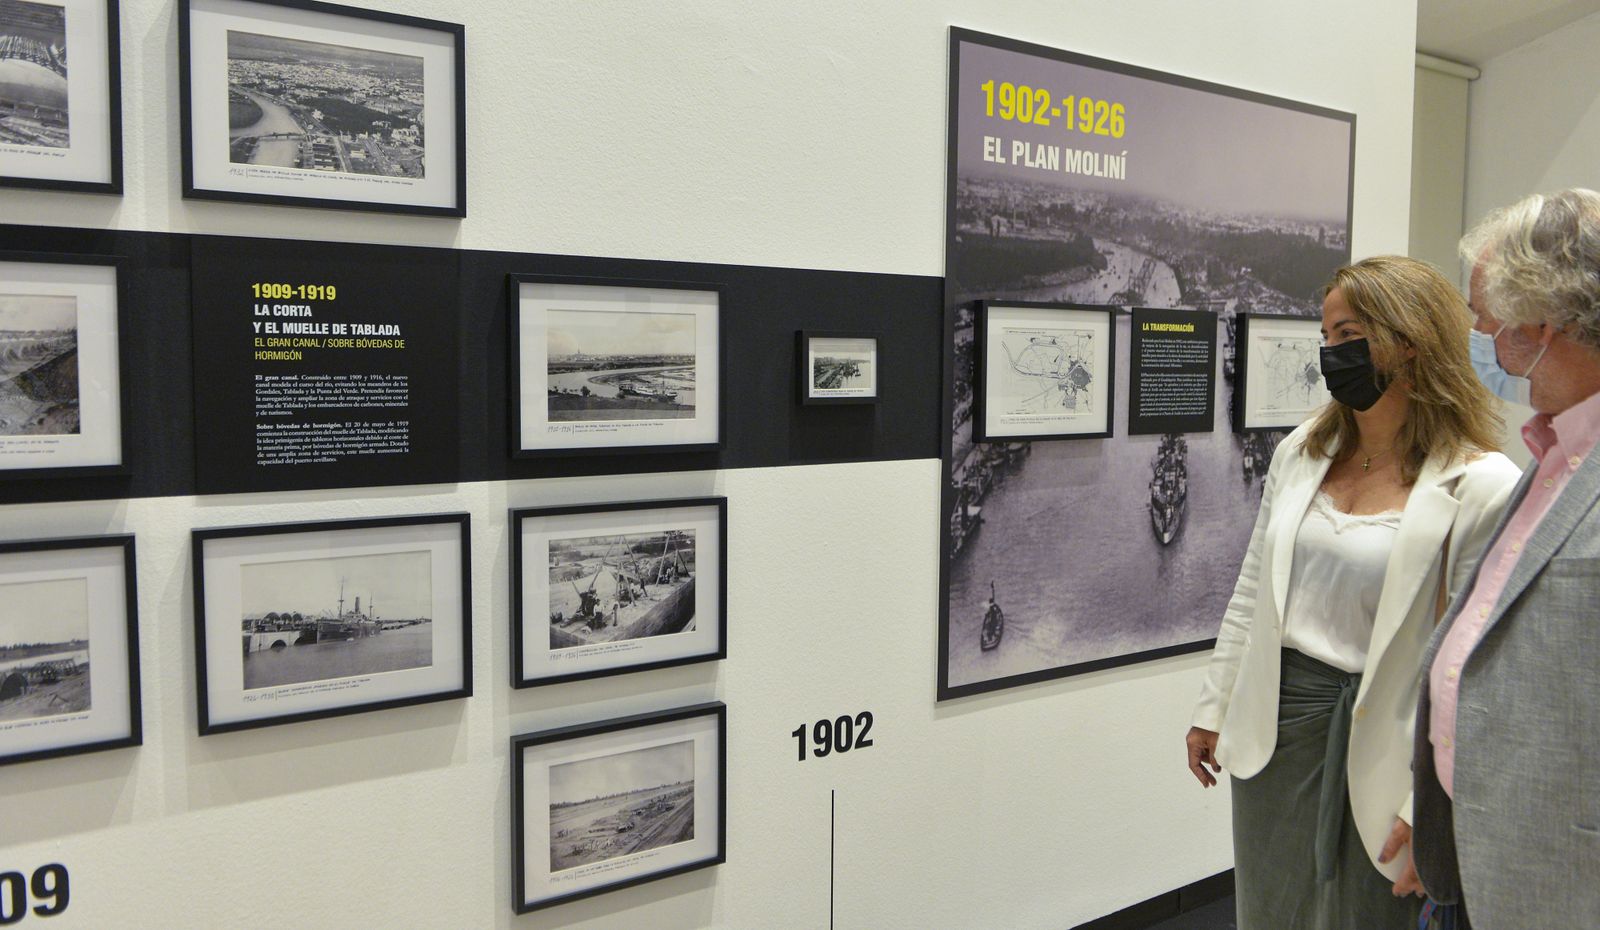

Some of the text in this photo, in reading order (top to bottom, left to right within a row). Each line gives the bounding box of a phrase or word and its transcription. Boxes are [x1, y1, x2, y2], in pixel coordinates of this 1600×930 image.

[981, 79, 1126, 139] 1902-1926
[983, 135, 1128, 181] EL PLAN MOLINÍ
[252, 283, 336, 301] 1909-1919
[254, 304, 312, 317] LA CORTA
[253, 322, 401, 336] Y EL MUELLE DE TABLADA
[1142, 322, 1195, 332] LA TRANSFORMACIÓN
[255, 338, 264, 348] EL
[267, 338, 290, 348] GRAN
[293, 338, 320, 348] CANAL
[328, 338, 354, 349] SOBRE
[356, 337, 392, 349] BÓVEDAS
[395, 339, 405, 349] DE
[255, 349, 302, 361] HORMIGÓN
[792, 711, 873, 761] 1902
[0, 863, 70, 926] 09
